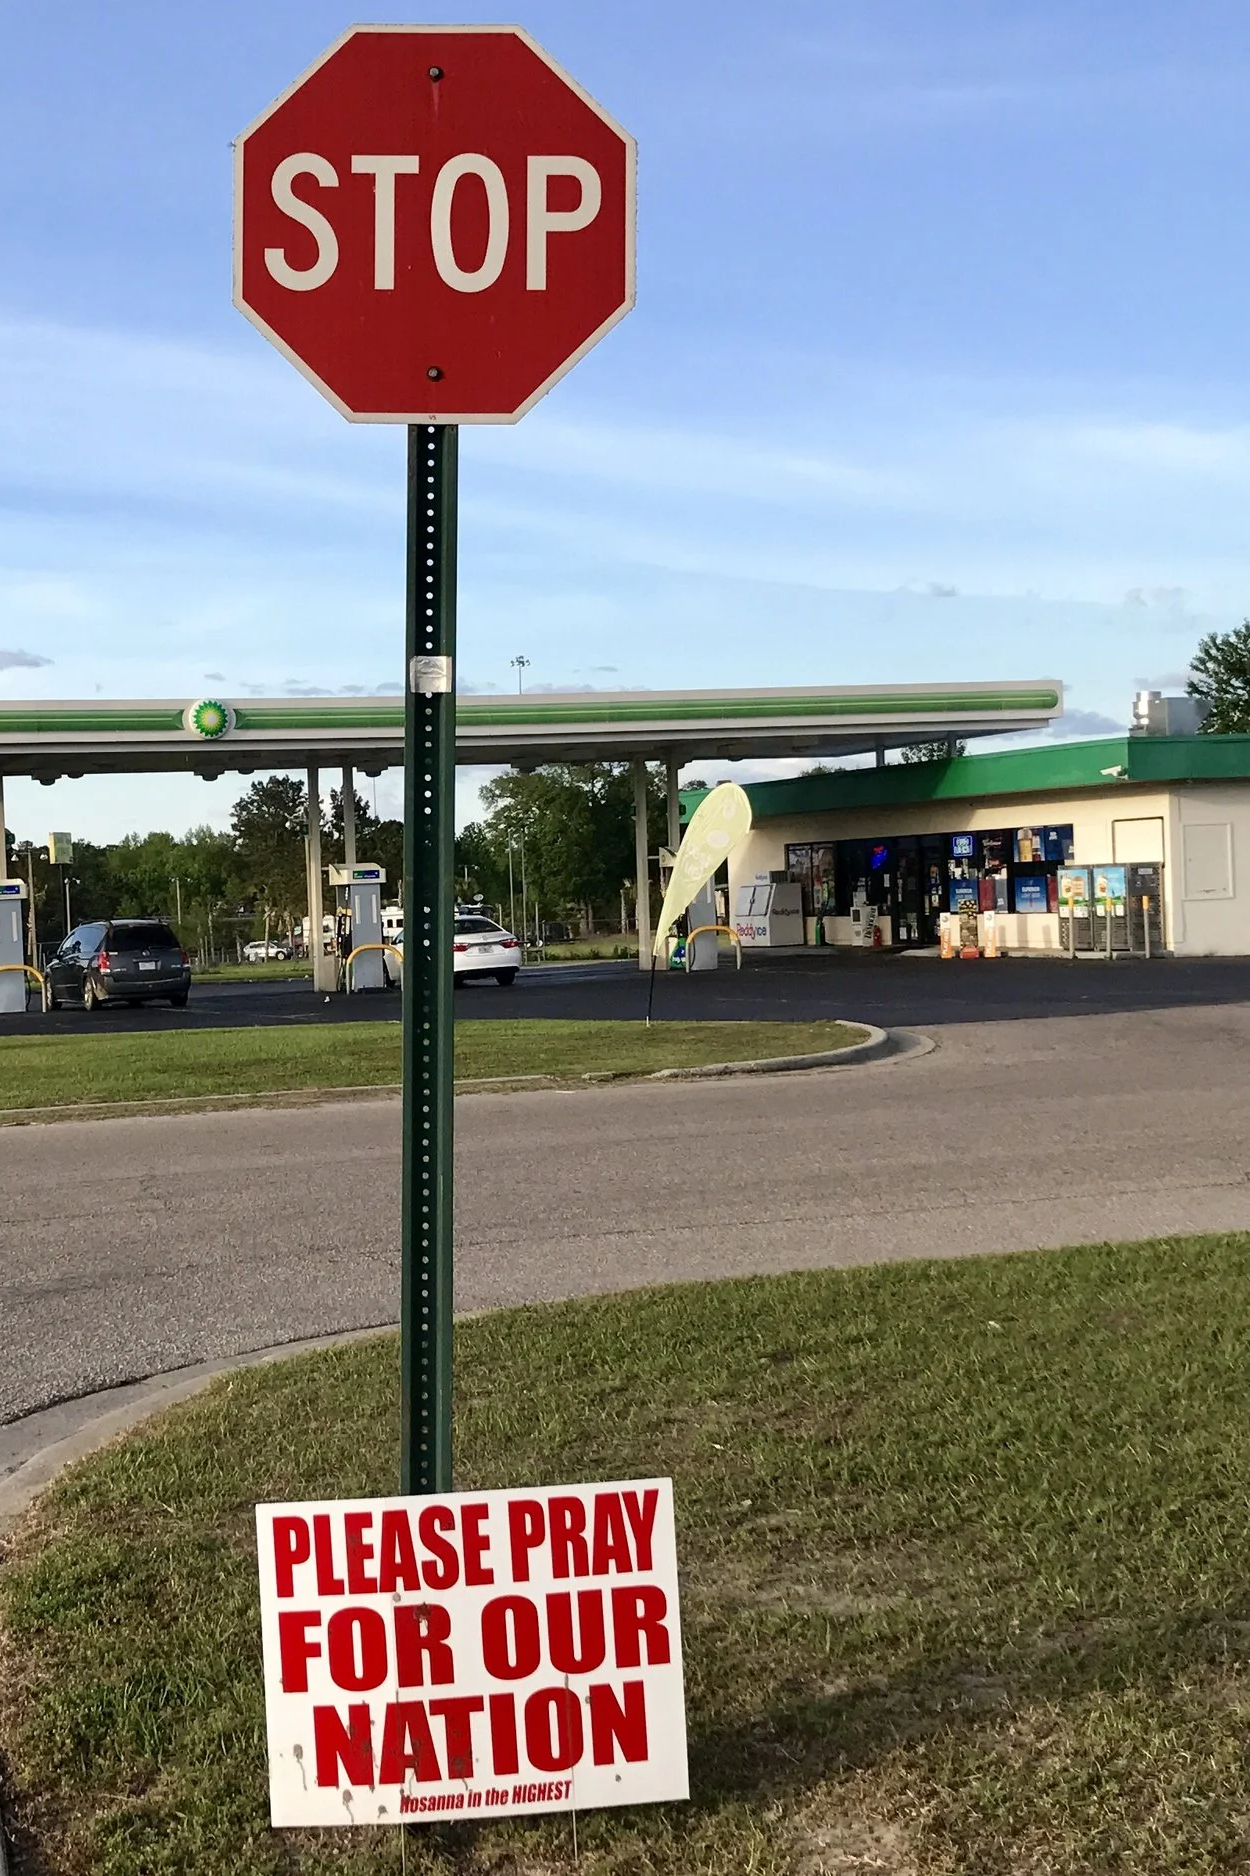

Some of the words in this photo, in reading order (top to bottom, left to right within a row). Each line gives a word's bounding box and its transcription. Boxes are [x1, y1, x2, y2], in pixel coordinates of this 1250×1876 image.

[264, 152, 602, 293] STOP
[272, 1503, 494, 1598] PLEASE
[507, 1488, 659, 1583] PRAY
[278, 1603, 454, 1693] FOR
[480, 1585, 671, 1680] OUR
[312, 1680, 649, 1787] NATION
[400, 1792, 464, 1813] Hosanna
[467, 1789, 482, 1807] in
[485, 1788, 509, 1806] the
[512, 1780, 572, 1804] HIGHEST
